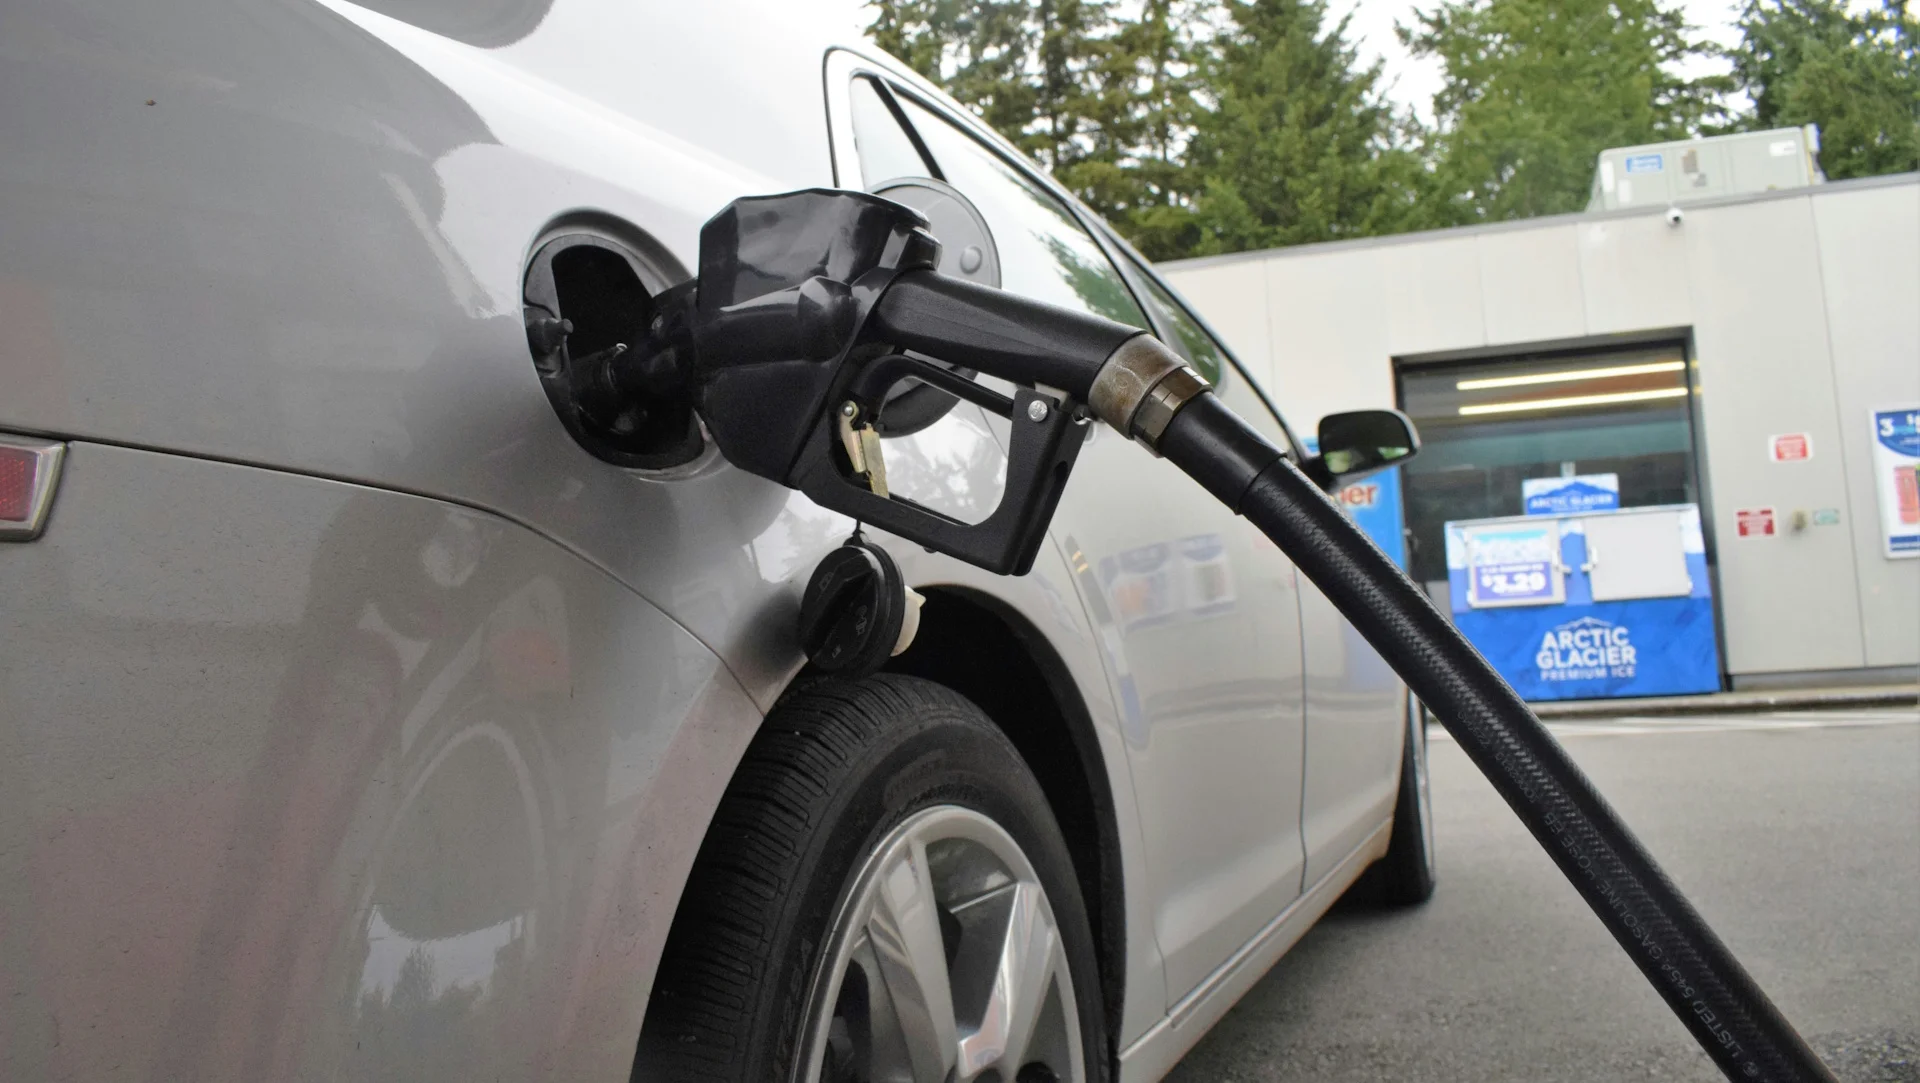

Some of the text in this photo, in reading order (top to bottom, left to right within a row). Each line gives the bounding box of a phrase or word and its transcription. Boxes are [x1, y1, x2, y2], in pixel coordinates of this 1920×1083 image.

[1879, 418, 1895, 437] 3
[1530, 493, 1614, 508] ARCTIC GLACIER
[1541, 627, 1629, 651] ARCTIC
[1536, 645, 1637, 670] GLACIER
[1541, 664, 1636, 681] PREMIUM ICE
[1596, 881, 1664, 960] GASOLINE
[1691, 999, 1744, 1059] LISTED
